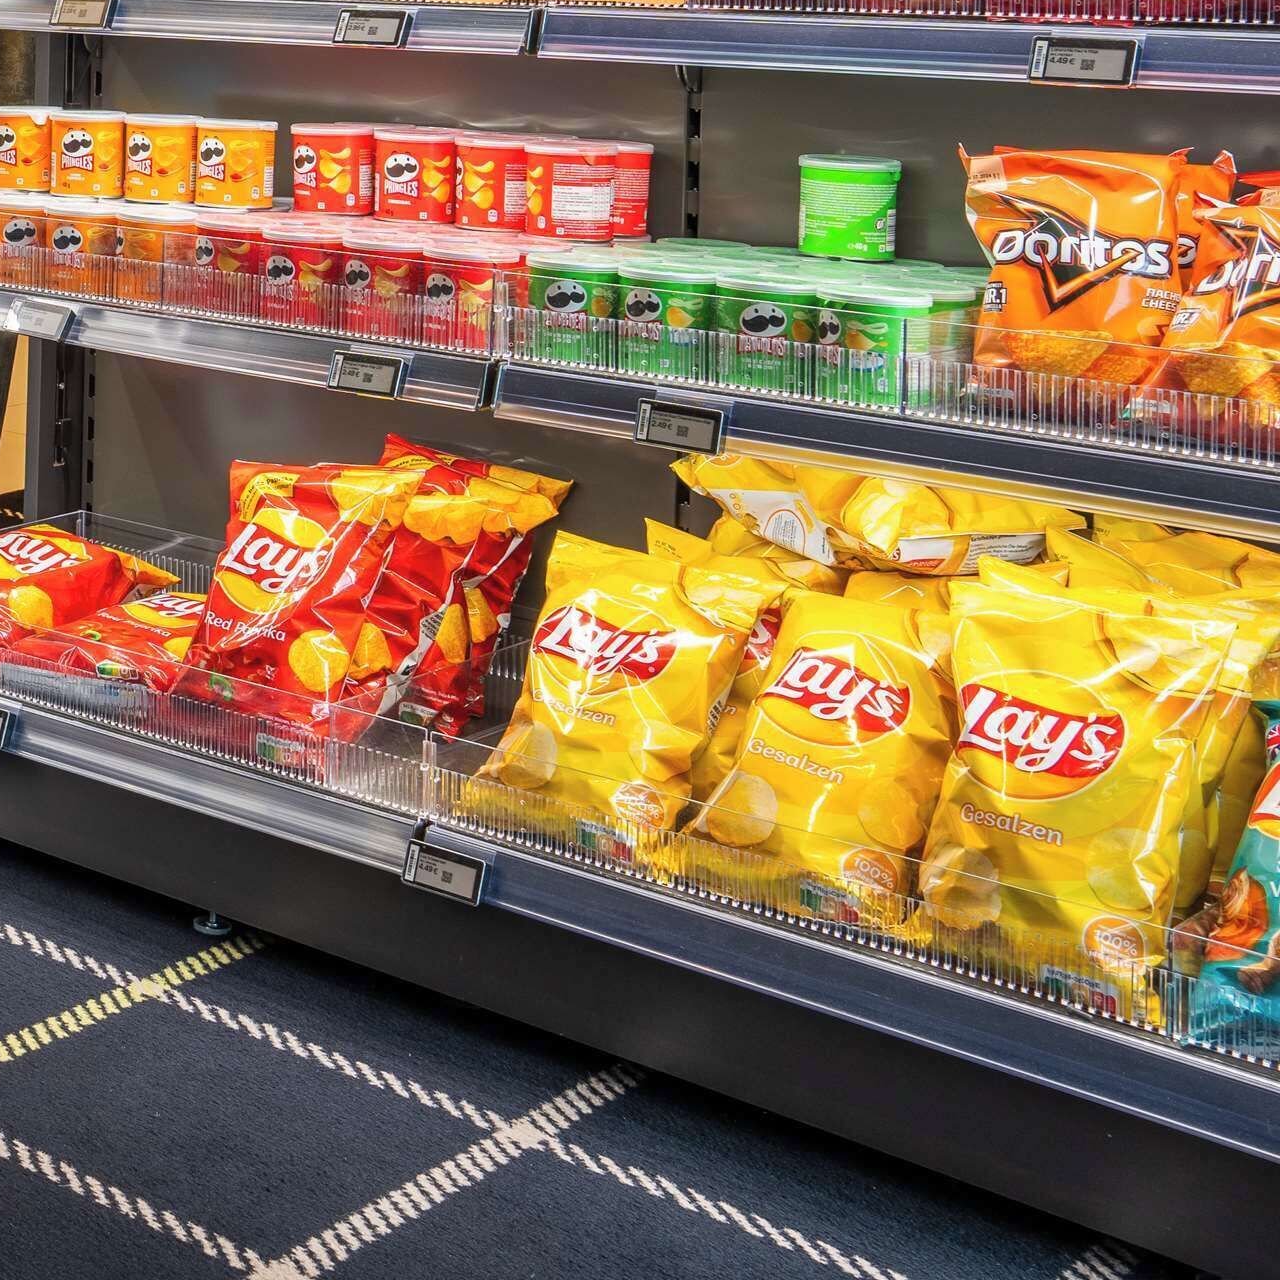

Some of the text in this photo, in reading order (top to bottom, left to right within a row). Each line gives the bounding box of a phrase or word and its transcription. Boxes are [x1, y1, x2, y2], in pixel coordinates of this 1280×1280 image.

[1050, 56, 1076, 66] 4.49 €
[61, 154, 94, 170] PRINGLES
[383, 180, 419, 198] PRINGLES
[992, 227, 1173, 279] Doritos
[221, 521, 333, 593] Lay's
[96, 610, 172, 638] Red Paprika
[205, 611, 286, 643] Red Paprika
[538, 605, 664, 679] Lay's
[531, 686, 617, 728] Gesalzen
[763, 653, 906, 722] Lay's
[962, 685, 1121, 773] Lay's
[748, 737, 846, 786] Gesalzen
[958, 800, 1065, 848] Gesalzen
[853, 855, 896, 890] 100%
